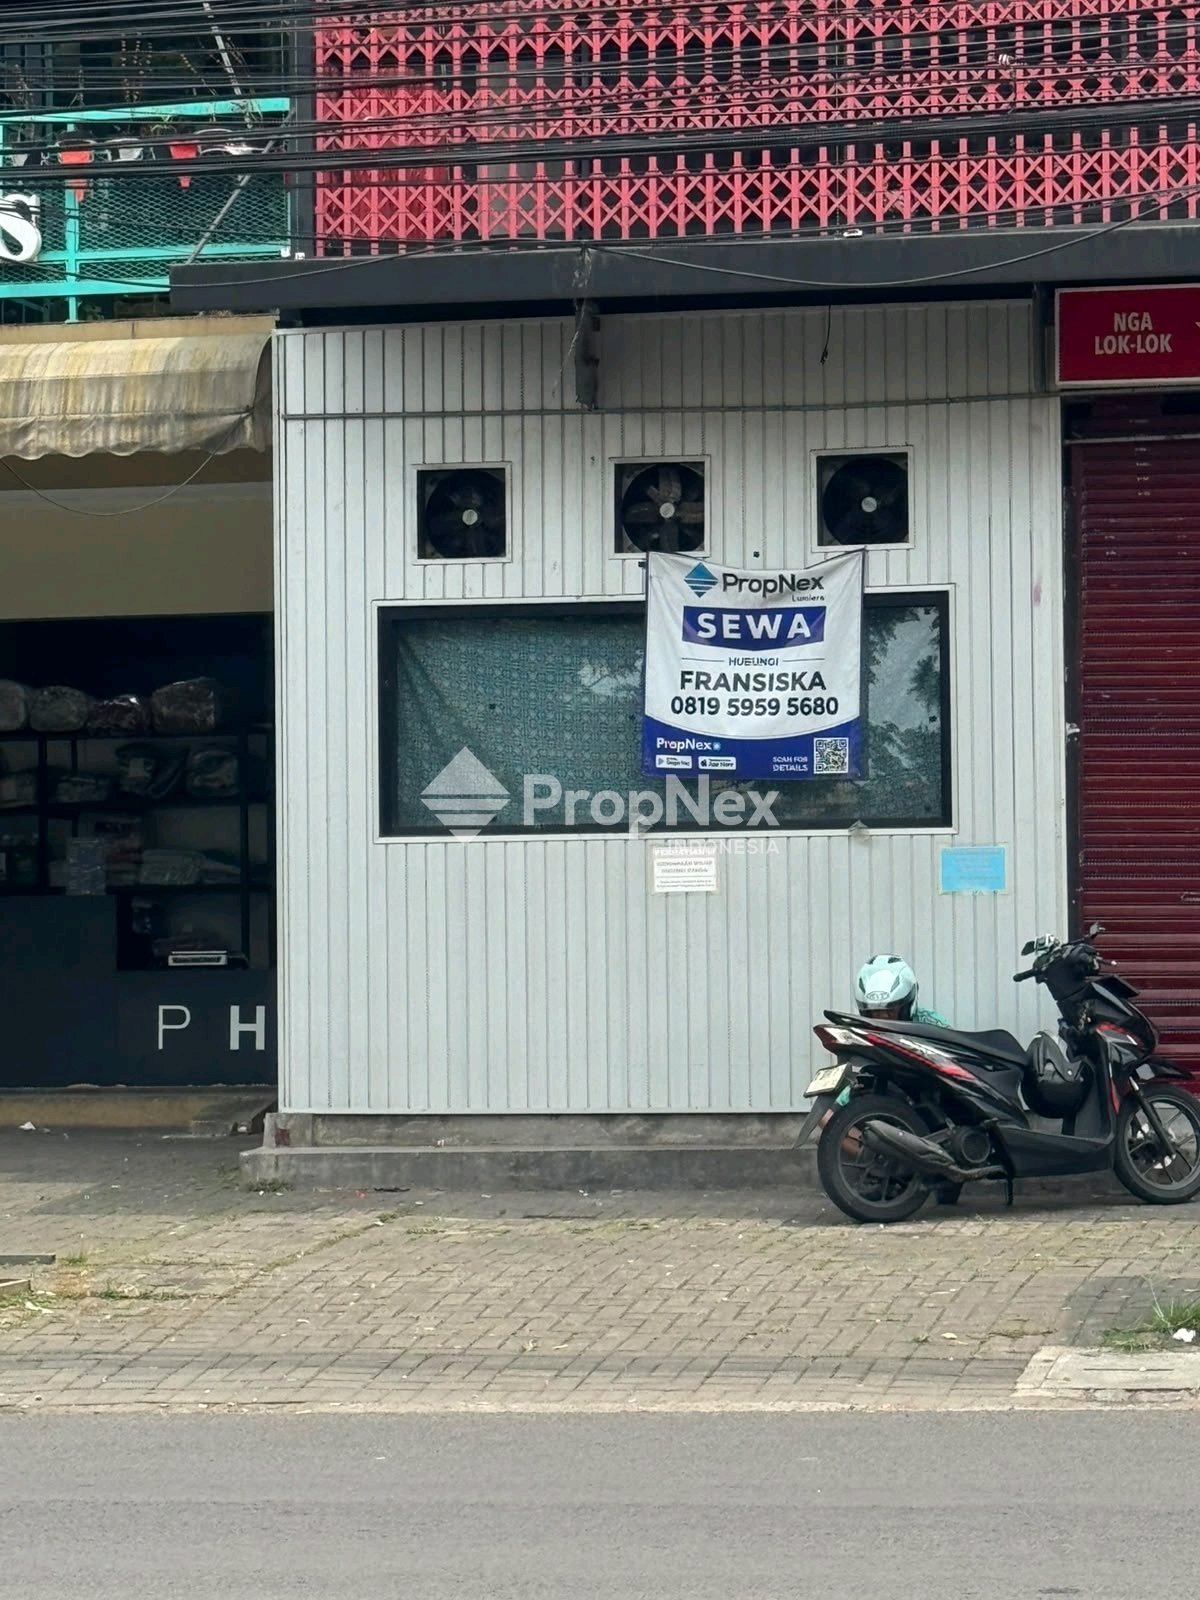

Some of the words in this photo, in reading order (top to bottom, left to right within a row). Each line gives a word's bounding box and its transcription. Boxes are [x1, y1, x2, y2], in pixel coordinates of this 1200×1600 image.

[1113, 312, 1153, 332] NGA
[1094, 333, 1173, 355] LOK-LOK
[722, 573, 825, 598] PropNex
[696, 613, 812, 639] SEWA
[680, 670, 827, 693] FRANSISKA
[670, 696, 720, 716] 0819
[727, 698, 780, 717] 5959
[786, 696, 839, 716] 5680
[656, 737, 713, 753] PropNex
[772, 763, 809, 772] DETAILS
